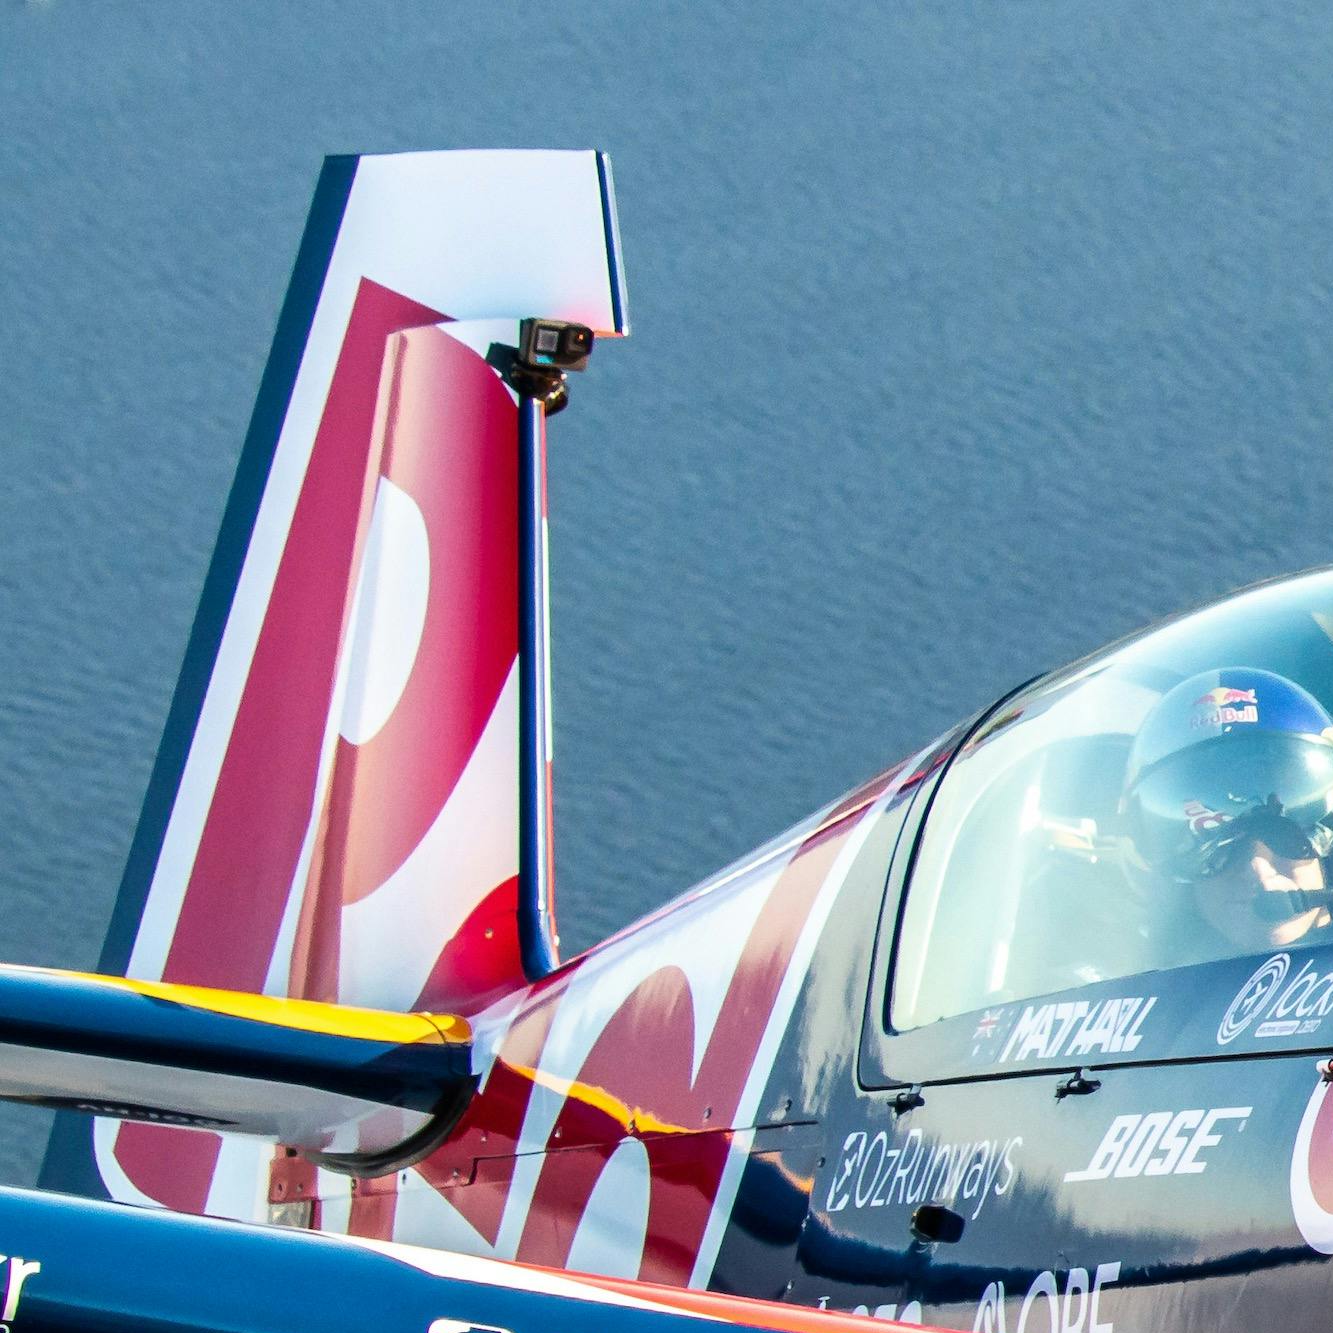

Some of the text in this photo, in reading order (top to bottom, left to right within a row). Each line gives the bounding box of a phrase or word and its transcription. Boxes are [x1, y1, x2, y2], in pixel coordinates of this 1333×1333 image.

[1221, 706, 1258, 723] Bull
[855, 1128, 1024, 1221] OzRunways
[1063, 1106, 1253, 1183] BOSE
